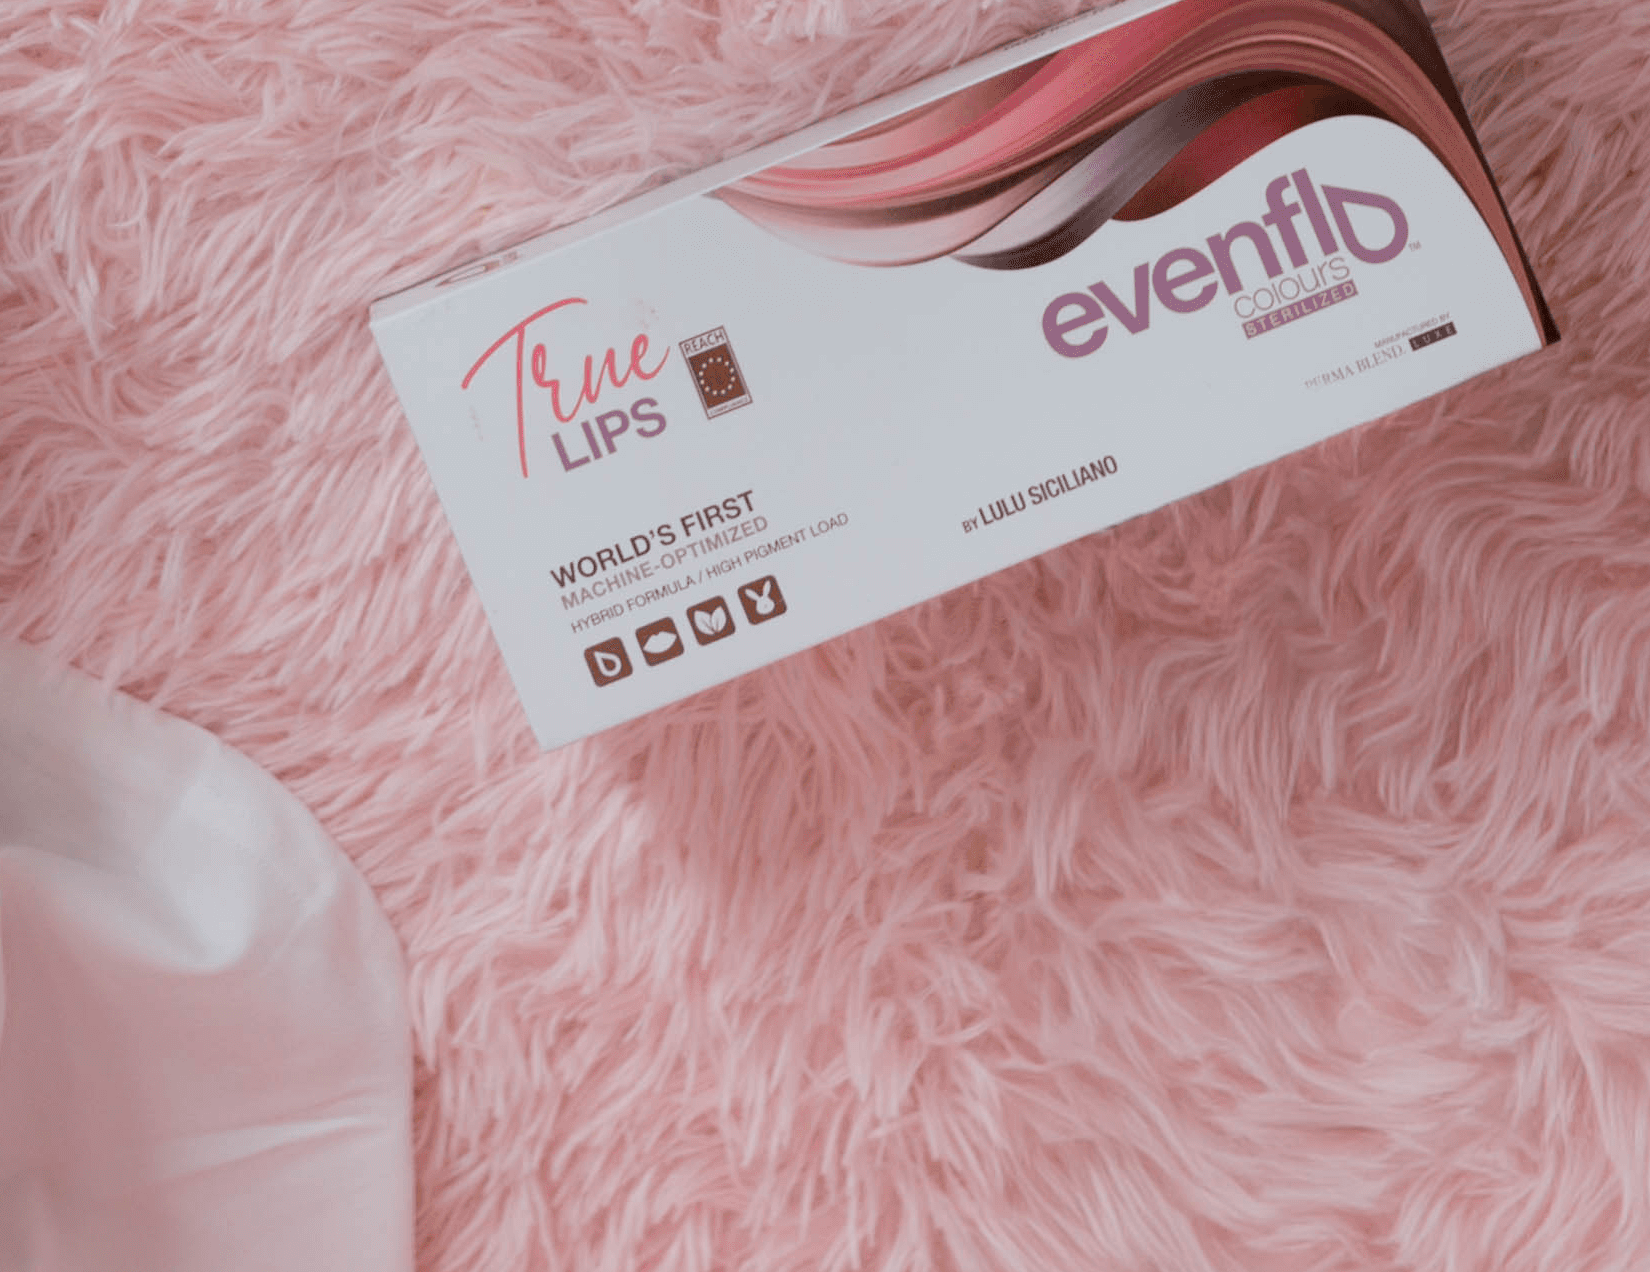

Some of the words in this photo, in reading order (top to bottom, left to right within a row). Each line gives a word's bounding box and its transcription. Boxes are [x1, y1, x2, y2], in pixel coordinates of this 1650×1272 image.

[1232, 256, 1351, 320] colours
[1243, 280, 1356, 337] STERILIZED
[684, 329, 726, 355] REACH
[461, 296, 671, 479] True
[551, 397, 667, 472] LIPS
[961, 517, 979, 534] BY
[978, 491, 1027, 526] LULU
[1027, 455, 1118, 505] SICILIANO
[550, 523, 676, 589] WORLD'S
[680, 489, 754, 537] FIRST
[560, 515, 769, 611] MACHINE-OPTIMIZED
[570, 602, 625, 634] HYBRID
[626, 574, 697, 613] FORMULA
[706, 555, 742, 580] HIGH
[743, 528, 809, 565] PIGMENT
[809, 512, 850, 539] LOAD
